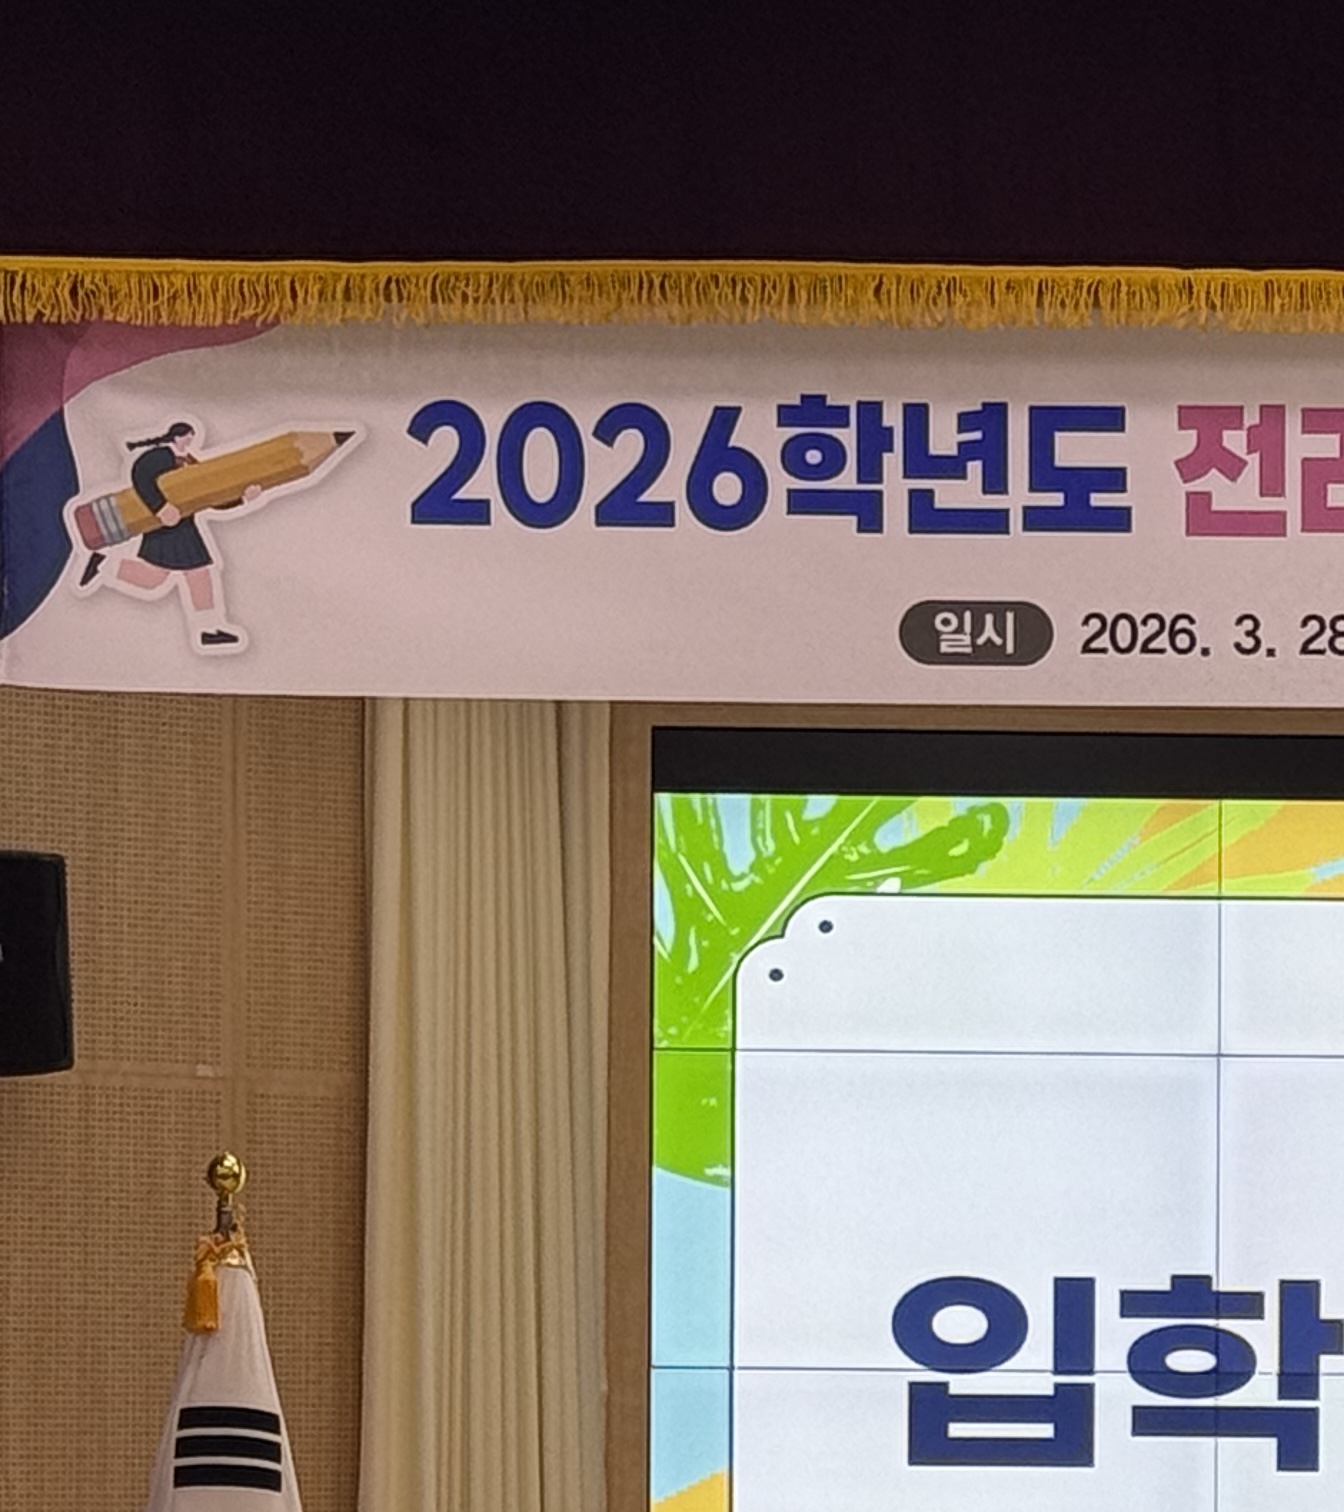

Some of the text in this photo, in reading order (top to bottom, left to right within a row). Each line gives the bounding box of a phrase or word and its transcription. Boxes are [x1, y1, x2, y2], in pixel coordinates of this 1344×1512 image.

[405, 393, 1133, 536] 2026학년도
[933, 610, 1017, 655] 일시
[1080, 612, 1212, 658] 2026.
[1232, 613, 1279, 658] 3.
